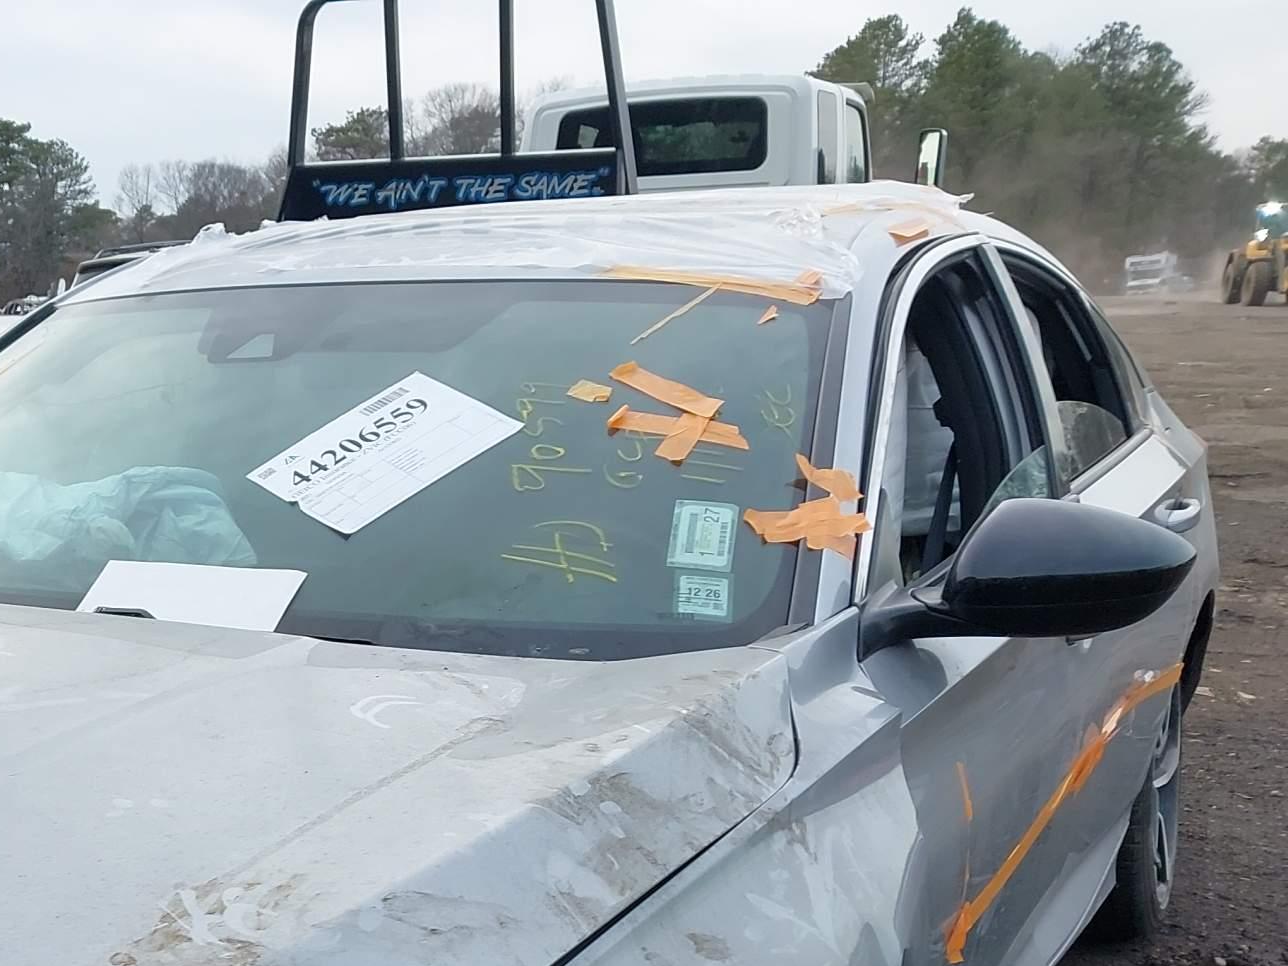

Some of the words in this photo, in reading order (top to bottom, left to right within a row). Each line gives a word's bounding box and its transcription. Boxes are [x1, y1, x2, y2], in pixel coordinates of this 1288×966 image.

[376, 174, 447, 209] AIN'T
[454, 175, 511, 200] THE
[292, 398, 428, 488] 44206559
[704, 507, 721, 524] 27
[687, 587, 702, 597] 12
[705, 588, 721, 599] 26
